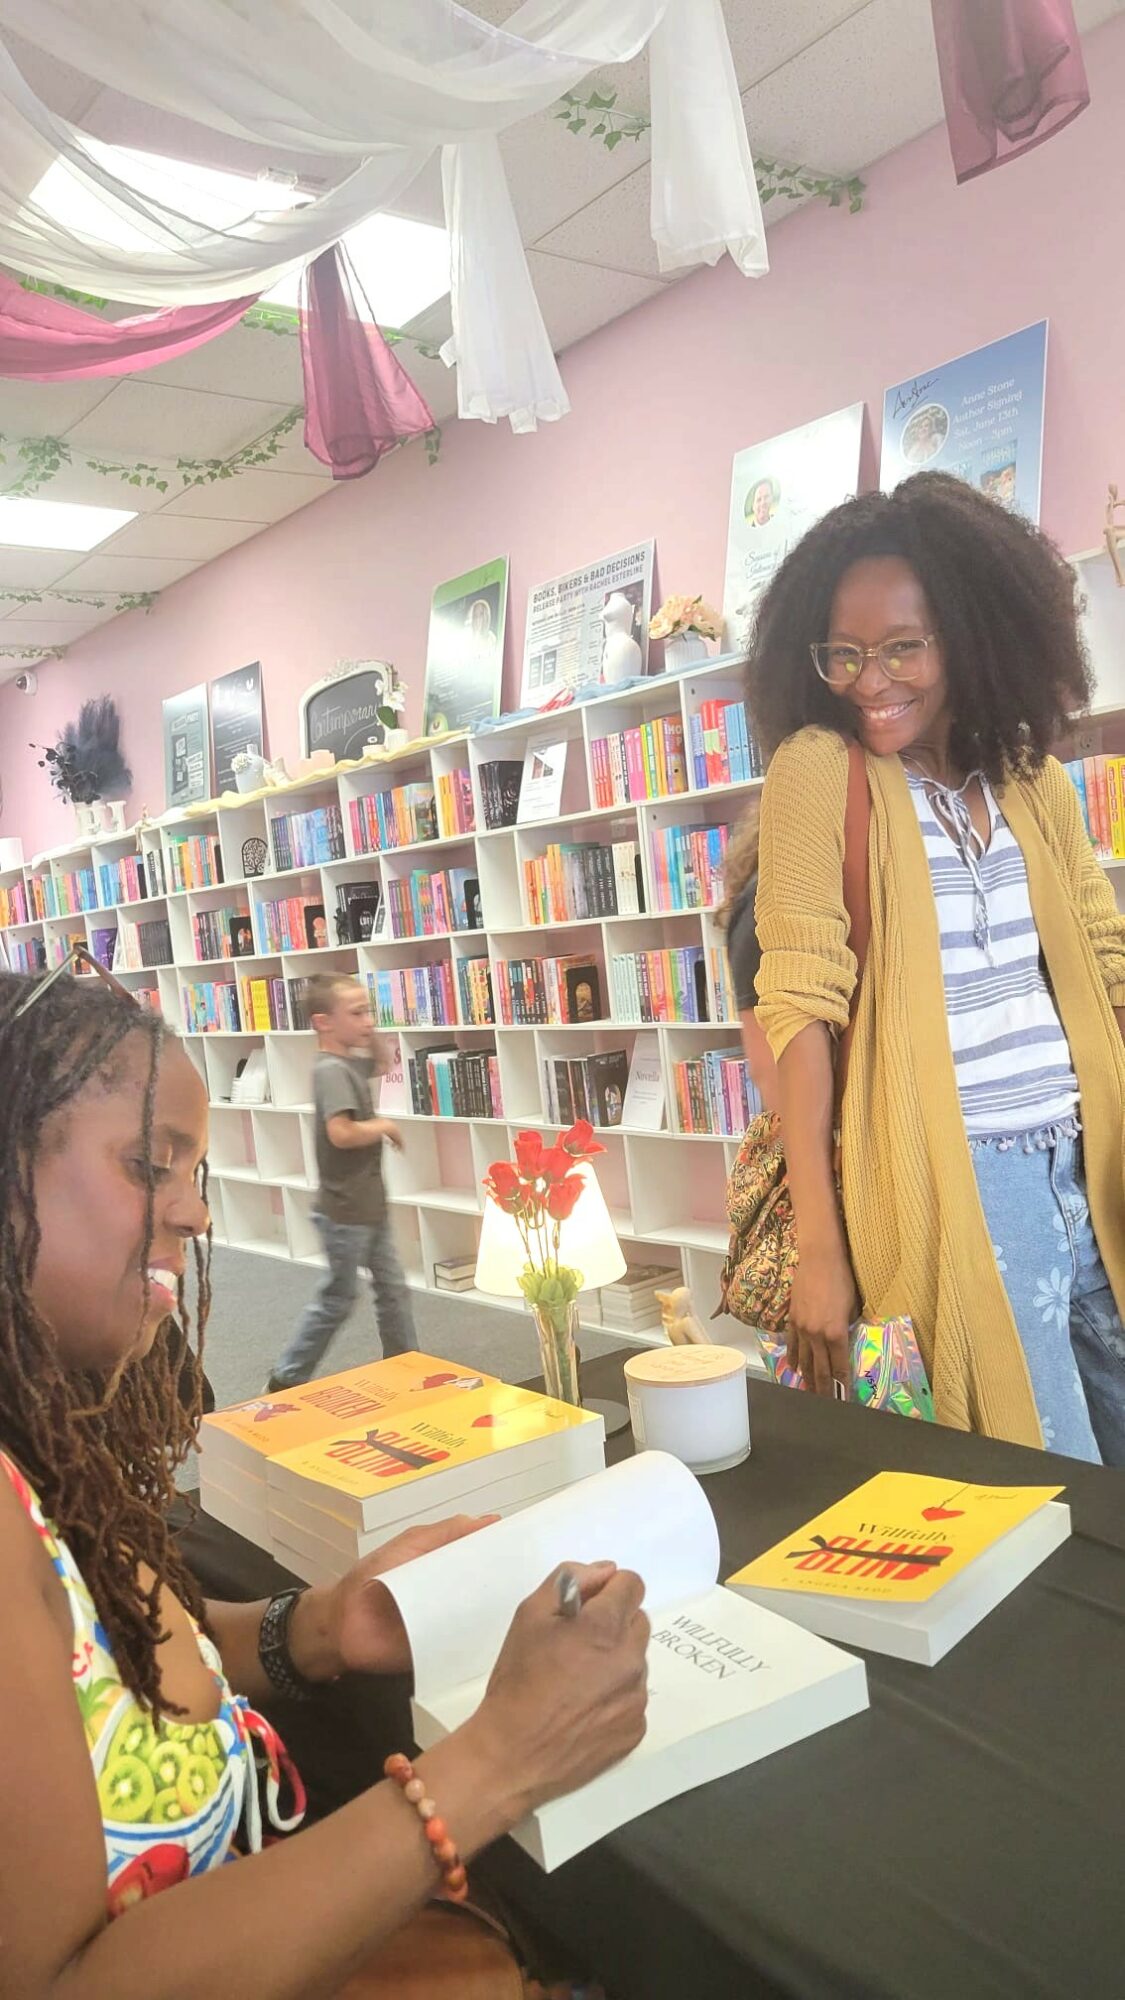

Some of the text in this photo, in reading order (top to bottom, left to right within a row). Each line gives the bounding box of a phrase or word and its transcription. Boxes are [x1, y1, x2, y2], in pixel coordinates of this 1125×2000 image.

[952, 389, 1023, 425] Author Signing
[961, 378, 1015, 407] Anne Stone
[558, 576, 583, 594] BIKERS
[590, 567, 605, 581] BAD
[606, 551, 646, 575] DECISIONS
[532, 598, 556, 613] RELEASE
[556, 592, 574, 605] PARTY
[589, 579, 611, 594] RACHEL
[635, 1071, 660, 1082] Novella
[298, 1385, 387, 1420] BROKEN
[858, 1521, 954, 1545] Willfully
[651, 1629, 737, 1680] BROKEN
[672, 1615, 772, 1673] WILLFULLY
